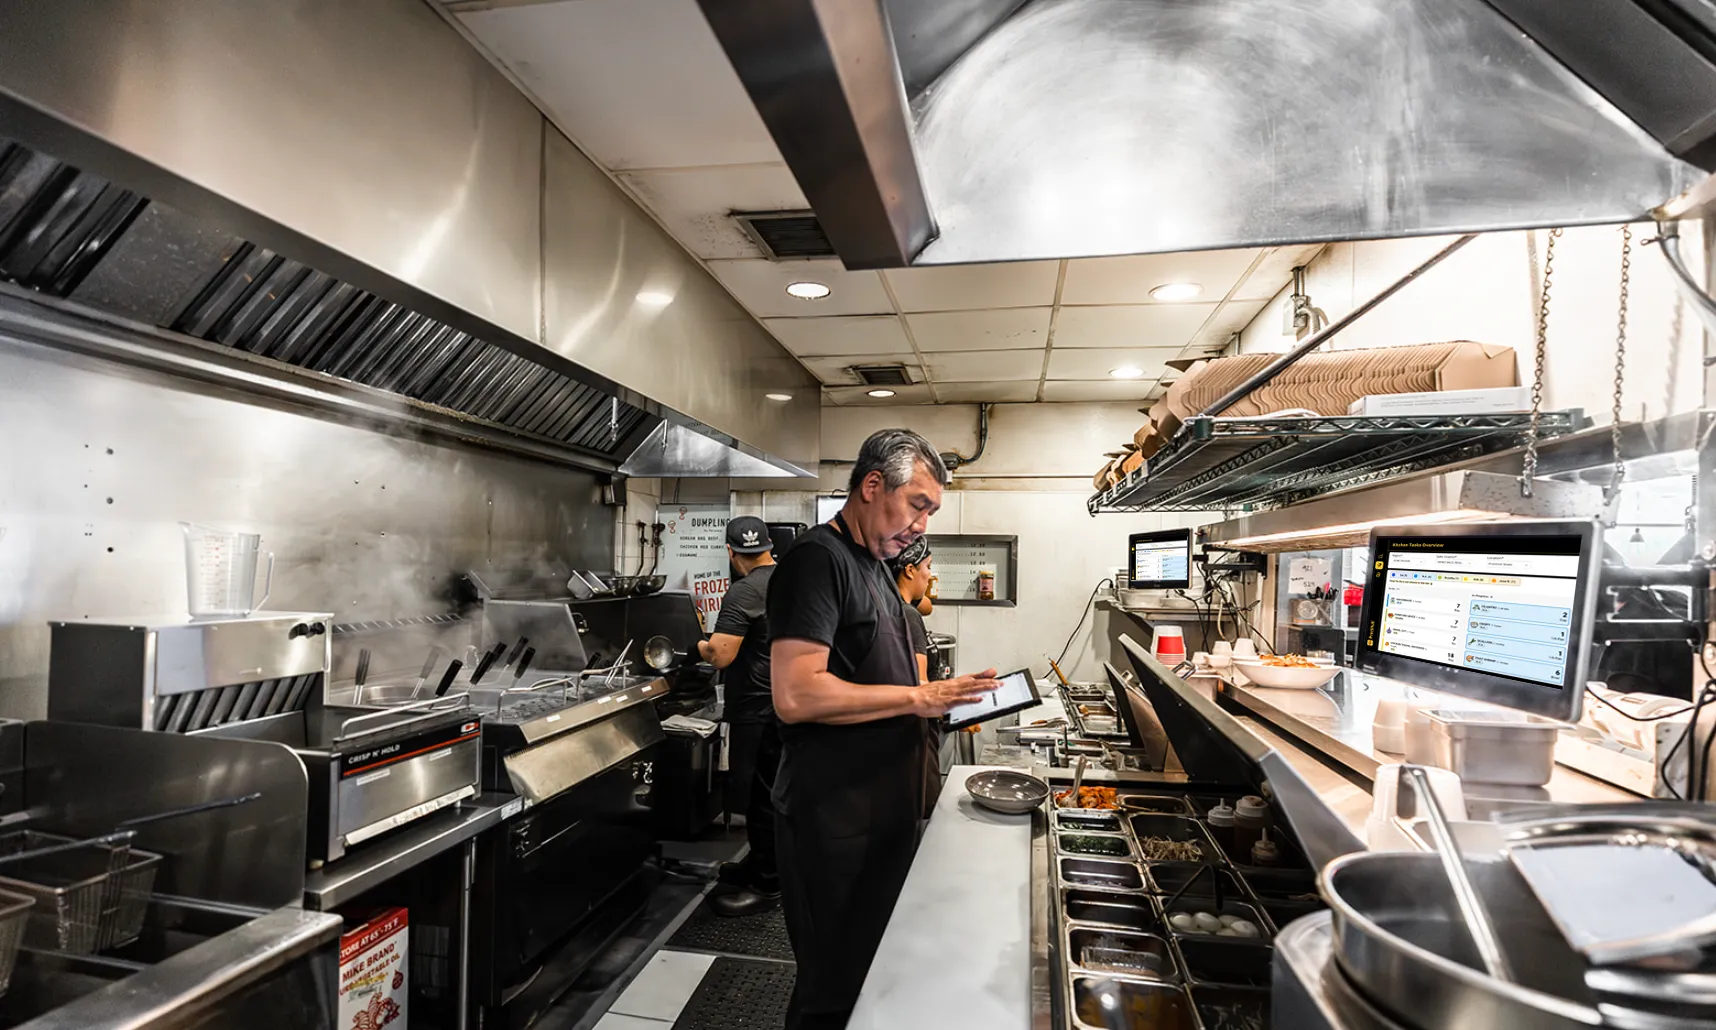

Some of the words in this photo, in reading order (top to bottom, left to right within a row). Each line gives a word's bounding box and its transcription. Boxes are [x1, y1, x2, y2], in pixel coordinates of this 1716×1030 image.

[694, 577, 729, 596] FROZE
[348, 752, 371, 764] CRISP
[381, 744, 400, 755] HOLD
[361, 935, 370, 946] AT
[342, 961, 365, 983] MIKE
[367, 943, 395, 967] BRAND
